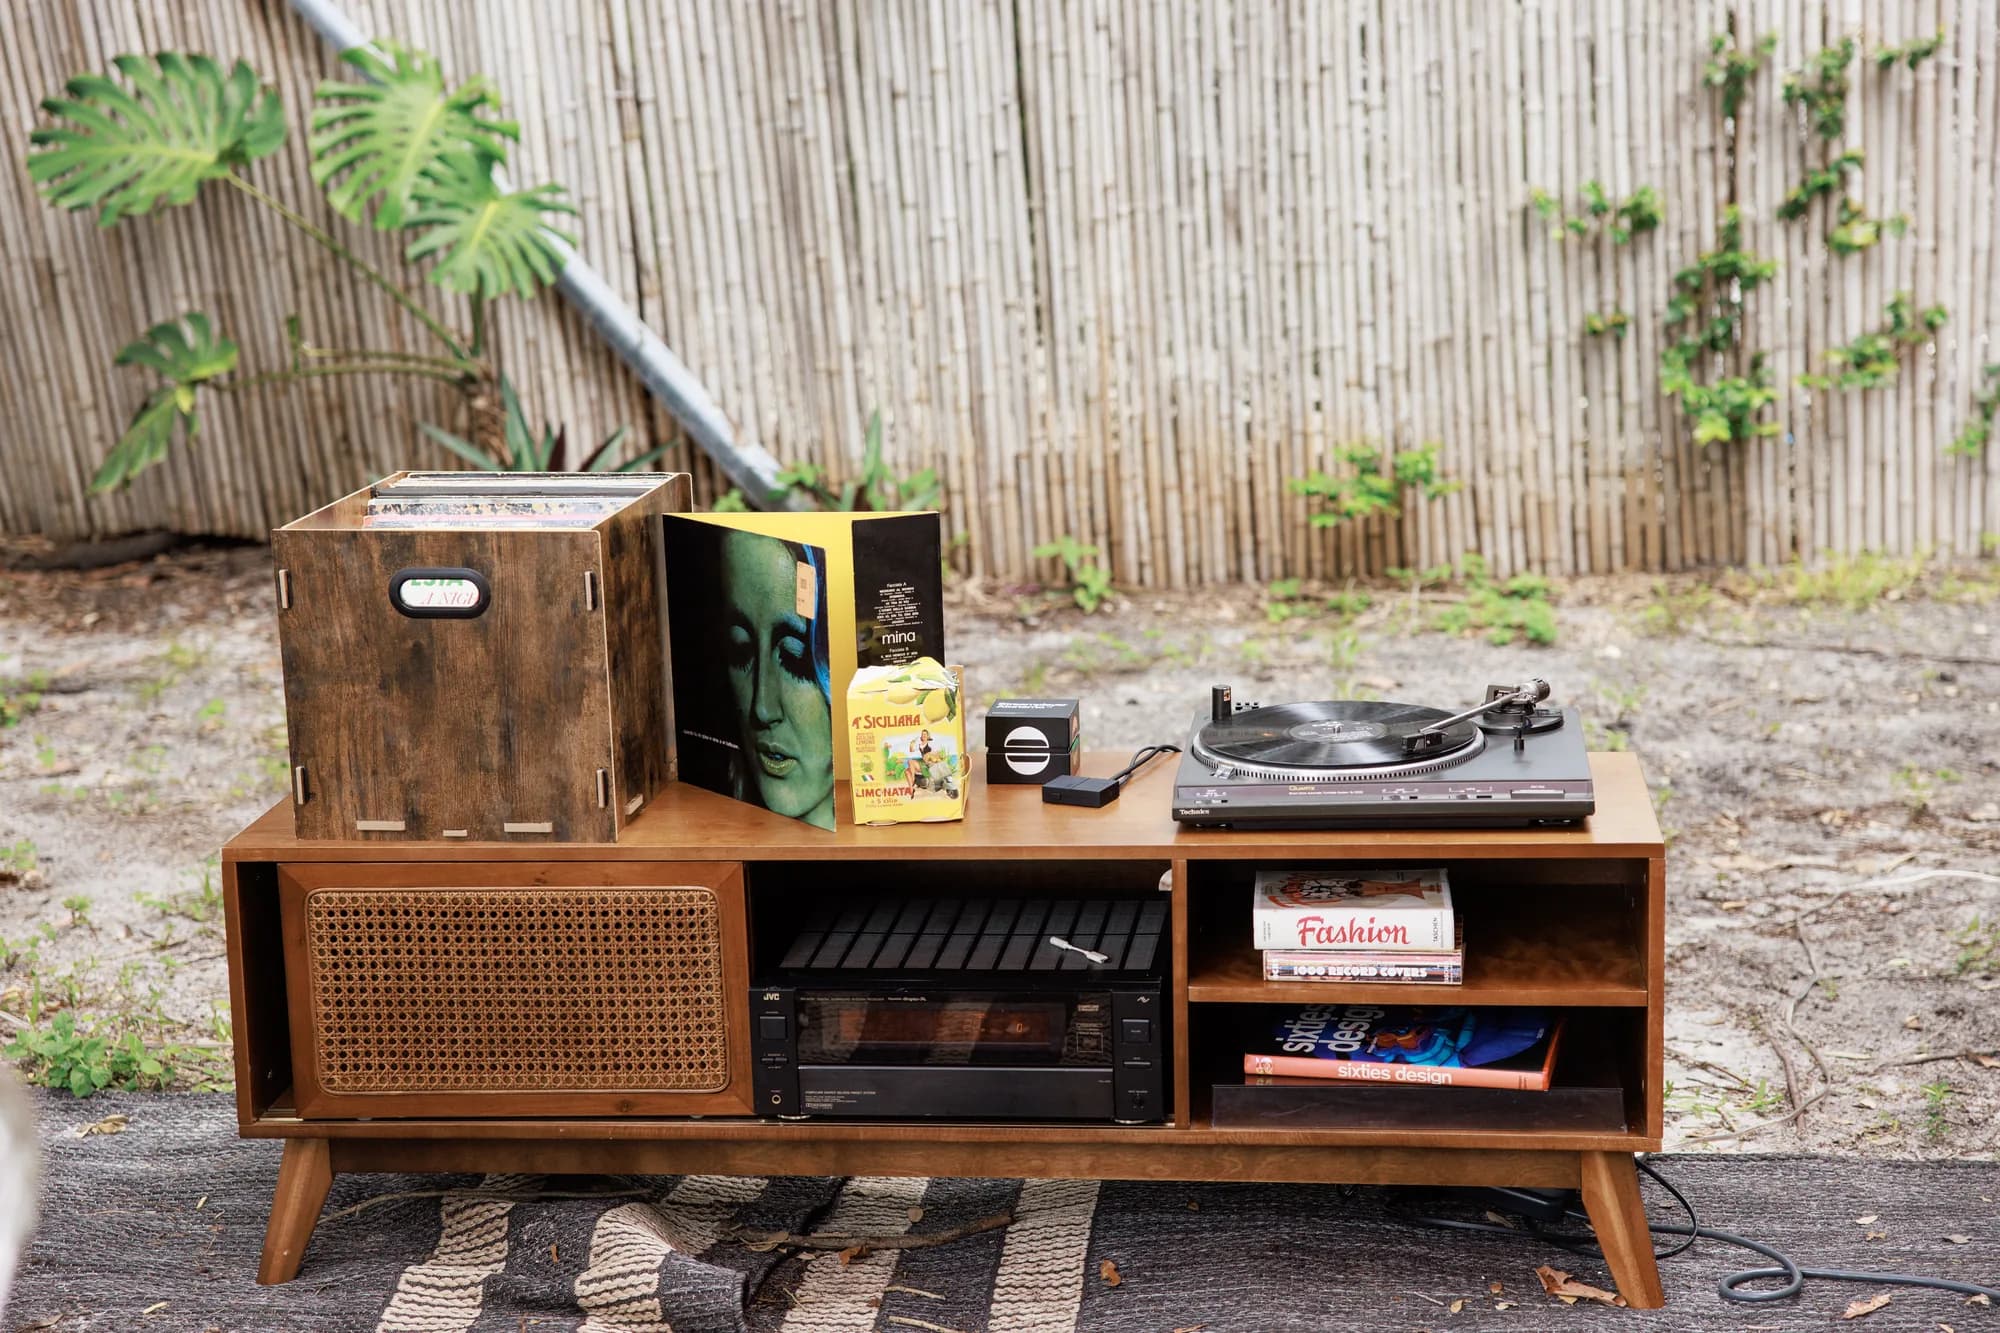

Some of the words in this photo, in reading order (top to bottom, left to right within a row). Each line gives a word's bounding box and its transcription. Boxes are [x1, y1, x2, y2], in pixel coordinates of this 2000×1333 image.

[882, 630, 916, 645] mina
[1179, 808, 1210, 816] Technics
[1296, 916, 1411, 947] Fashion
[1293, 966, 1326, 977] 1000
[1328, 966, 1378, 977] RECORD
[1380, 967, 1428, 978] COVERS
[763, 993, 780, 1001] JVC
[1275, 1005, 1338, 1053] sixties
[1337, 1063, 1392, 1081] sixties
[1395, 1066, 1453, 1085] design
